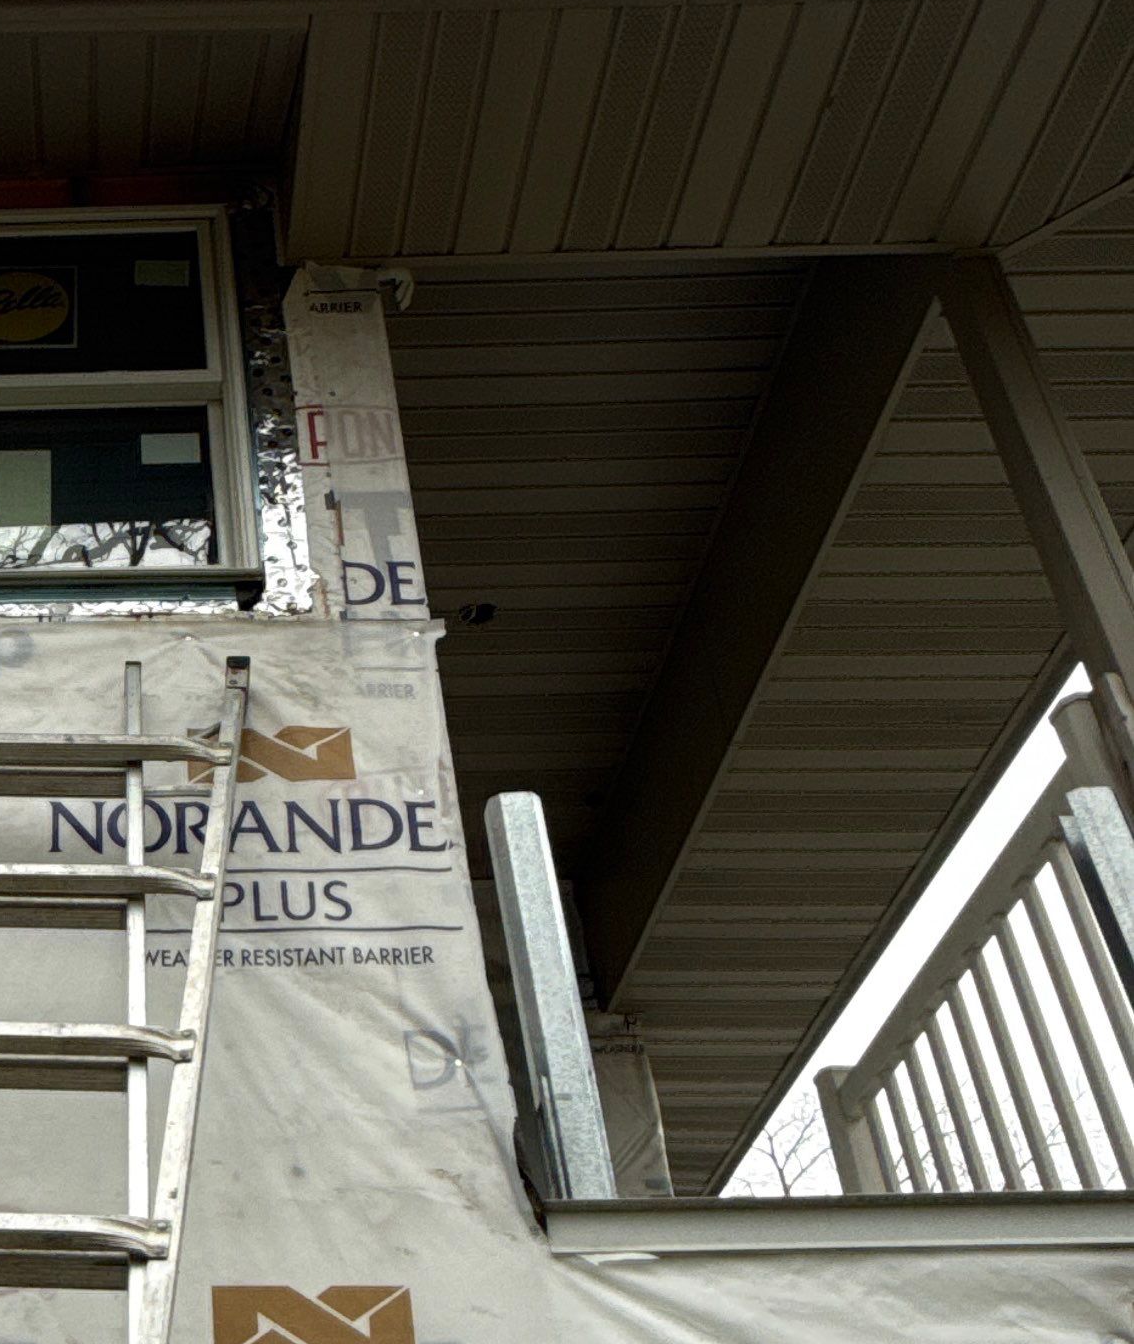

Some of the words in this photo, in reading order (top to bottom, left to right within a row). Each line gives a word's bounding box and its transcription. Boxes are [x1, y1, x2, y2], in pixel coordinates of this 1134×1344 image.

[49, 798, 456, 854] NORANDE
[220, 880, 352, 922] PLUS
[145, 949, 235, 968] WEAER
[241, 947, 345, 967] RESISTANT
[353, 946, 434, 965] BARRIER
